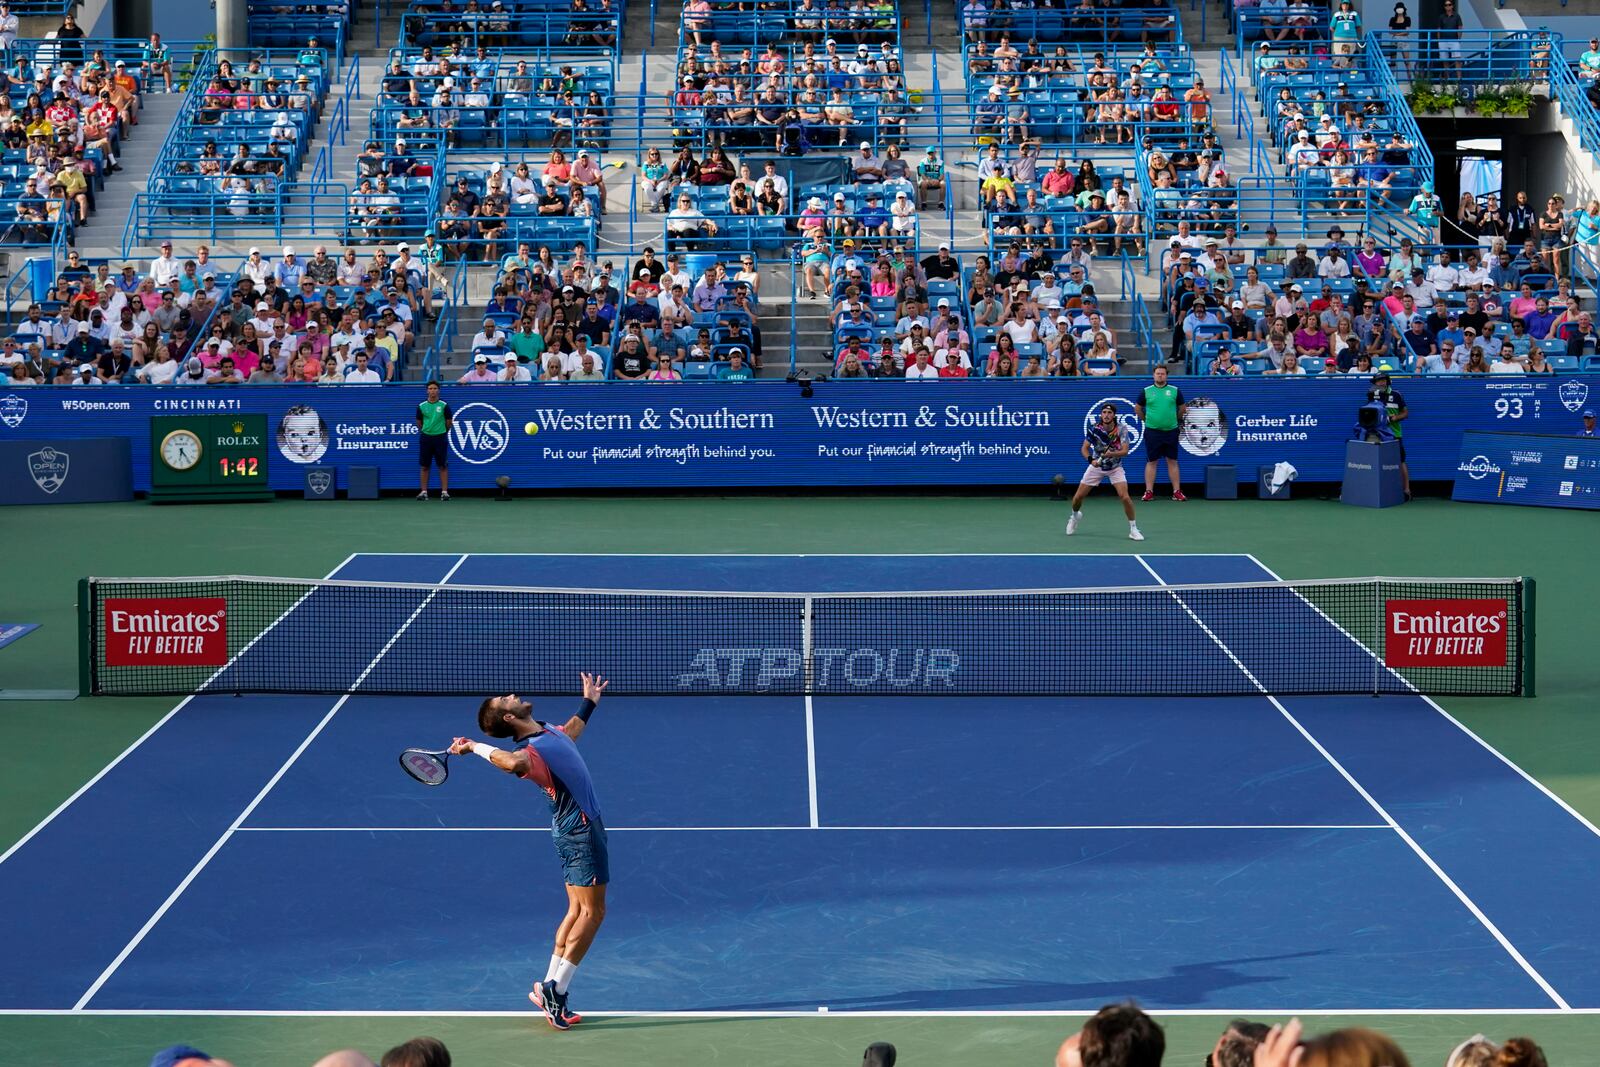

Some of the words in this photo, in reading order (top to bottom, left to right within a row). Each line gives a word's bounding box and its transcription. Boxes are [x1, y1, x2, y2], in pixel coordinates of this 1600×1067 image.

[62, 400, 130, 411] WSOpen.com
[154, 400, 241, 409] CINCINNATI
[1494, 398, 1524, 418] 93
[535, 408, 632, 431] Western
[639, 407, 662, 430] &
[669, 407, 774, 430] Southern
[811, 406, 908, 428] Western
[914, 405, 937, 427] &
[945, 404, 1051, 427] Southern
[1235, 415, 1286, 427] Gerber
[1289, 414, 1318, 427] Life
[336, 423, 387, 435] Gerber
[390, 423, 419, 435] Life
[452, 420, 504, 450] W&S
[1236, 430, 1308, 442] Insurance
[217, 436, 260, 446] ROLEX
[336, 438, 409, 450] Insurance
[543, 447, 564, 459] Put
[567, 450, 588, 459] our
[592, 444, 642, 465] financial
[645, 443, 700, 465] strength
[703, 445, 747, 458] behind
[750, 448, 776, 460] you.
[818, 445, 839, 456] Put
[842, 447, 863, 456] our
[866, 441, 917, 461] financial
[920, 440, 975, 462] strength
[979, 443, 1021, 455] behind
[1024, 446, 1050, 458] you.
[220, 457, 258, 476] 1:42
[1457, 461, 1501, 473] JobsOhio
[111, 609, 221, 633] Emirates
[1392, 610, 1502, 634] Emirates
[128, 635, 152, 654] FLY
[155, 635, 204, 654] BETTER
[1408, 637, 1433, 656] FLY
[1435, 637, 1484, 655] BETTER
[671, 649, 801, 687] ATP
[813, 648, 960, 687] TOUR
